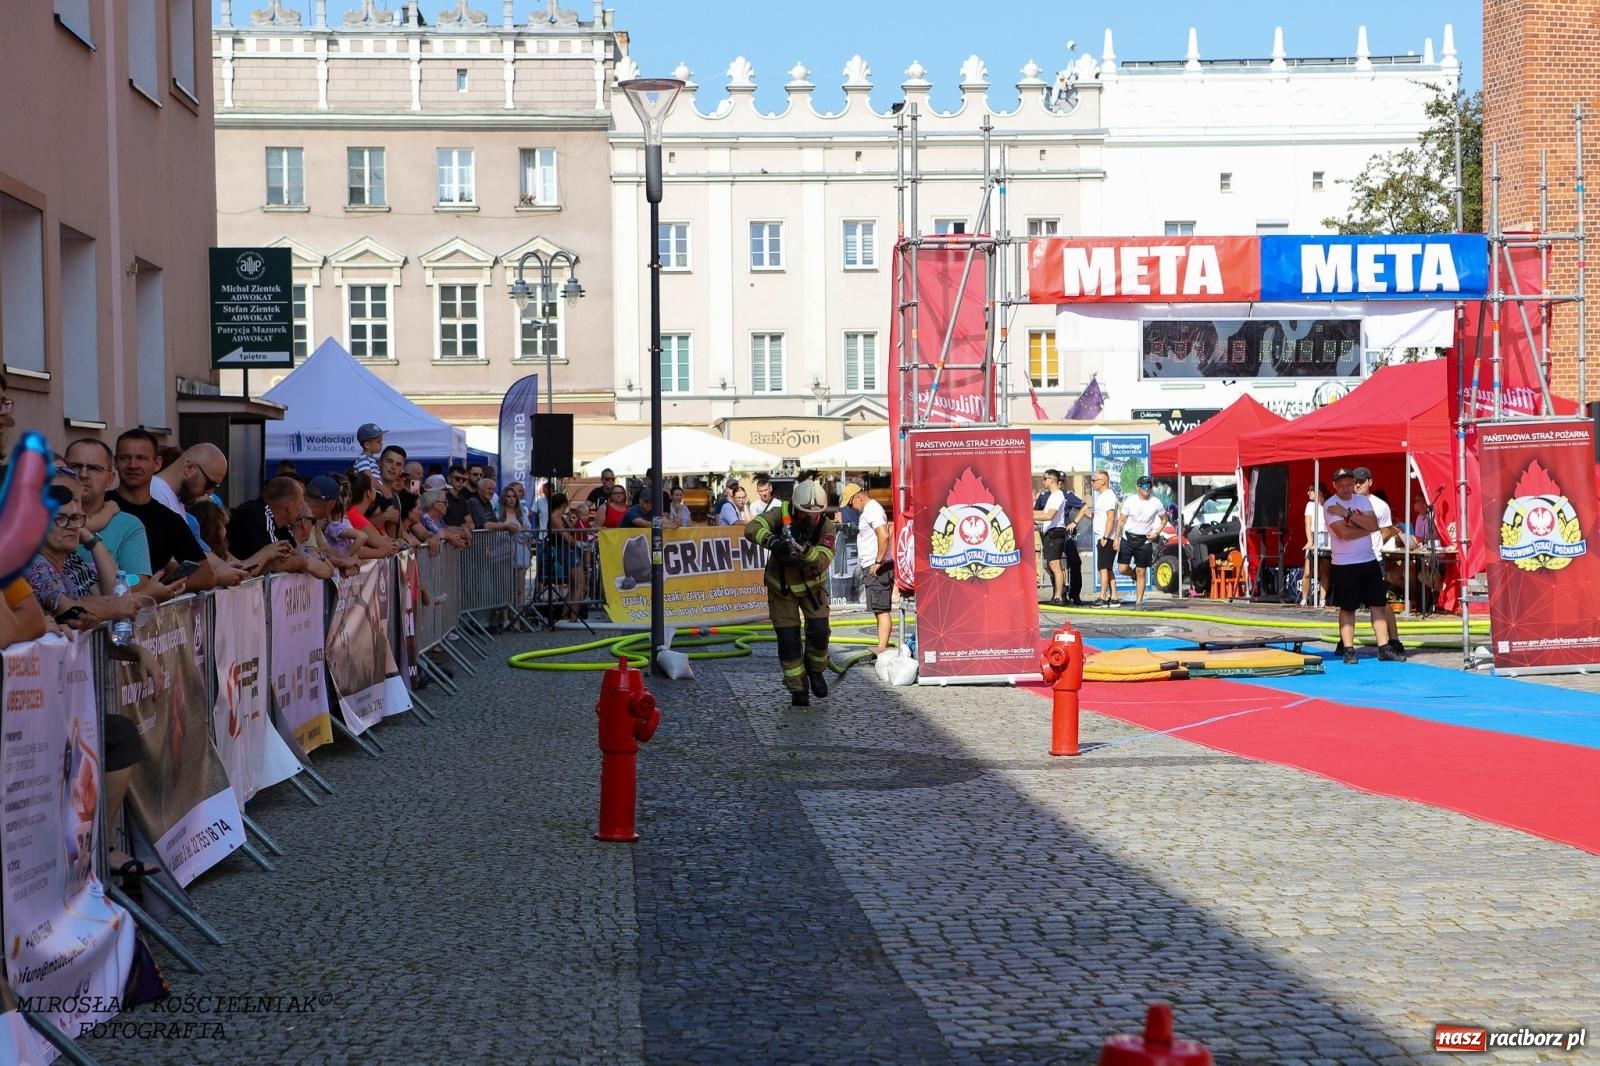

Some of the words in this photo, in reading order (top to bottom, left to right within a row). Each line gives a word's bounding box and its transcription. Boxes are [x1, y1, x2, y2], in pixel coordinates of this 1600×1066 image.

[1063, 245, 1225, 297] META
[1300, 243, 1461, 294] META
[251, 285, 281, 293] Zientek
[223, 305, 248, 313] Stefan
[250, 305, 280, 313] Zientek
[217, 326, 250, 335] Patrycja
[305, 435, 355, 445] Wodociągi
[1483, 433, 1531, 442] PAŃSTWOWA
[1532, 432, 1554, 440] STRAŻ
[1555, 430, 1589, 438] POŻARNA
[915, 440, 965, 449] PAŃSTWOWA
[966, 439, 988, 447] STRAŻ
[990, 438, 1026, 447] POŻARNA
[931, 555, 966, 567] PAŃSTWOWA
[967, 550, 985, 560] STRAŻ
[987, 554, 1017, 565] POŻARNA
[205, 827, 219, 843] 18
[212, 818, 232, 837] 74
